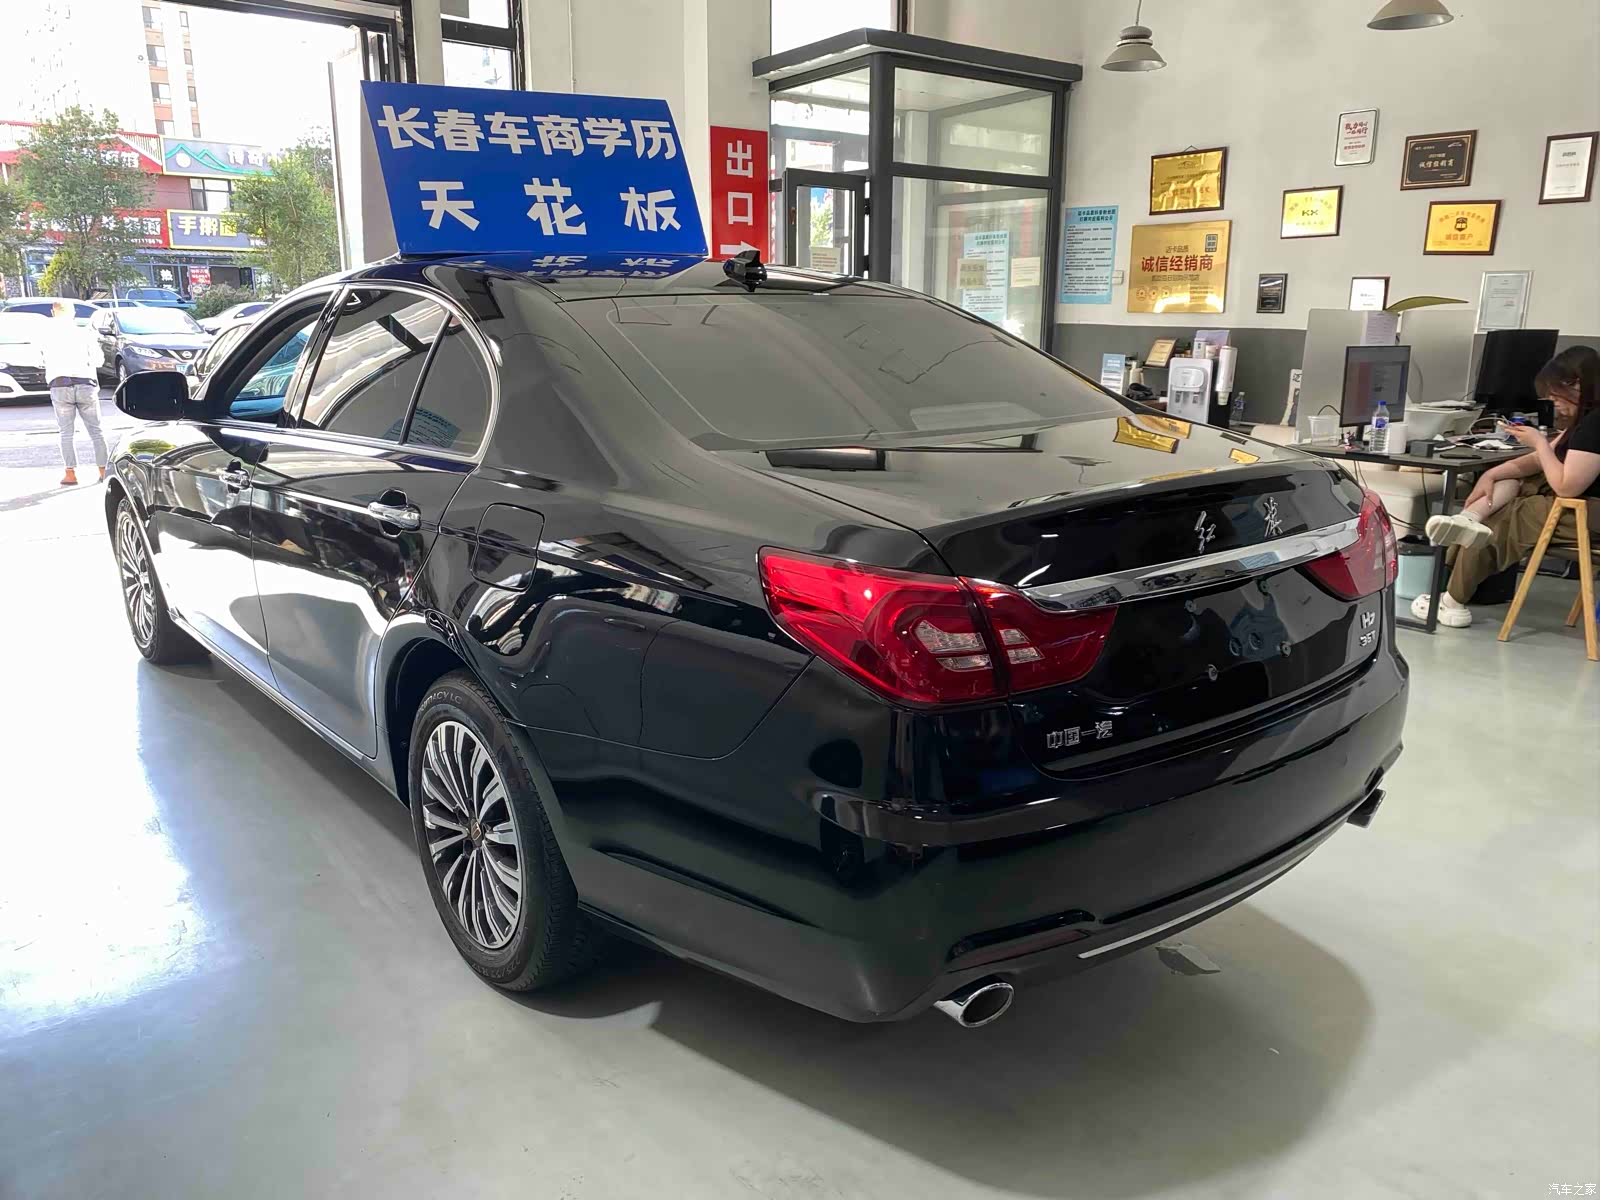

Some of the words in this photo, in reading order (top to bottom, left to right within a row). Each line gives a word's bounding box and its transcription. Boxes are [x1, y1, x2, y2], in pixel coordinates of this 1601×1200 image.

[377, 104, 677, 160] 长春车商学历
[726, 140, 754, 226] 出口
[418, 177, 681, 236] 天花板
[1141, 254, 1214, 272] 诚信经销商
[1361, 611, 1376, 629] H7
[1046, 720, 1113, 749] 中国一汽
